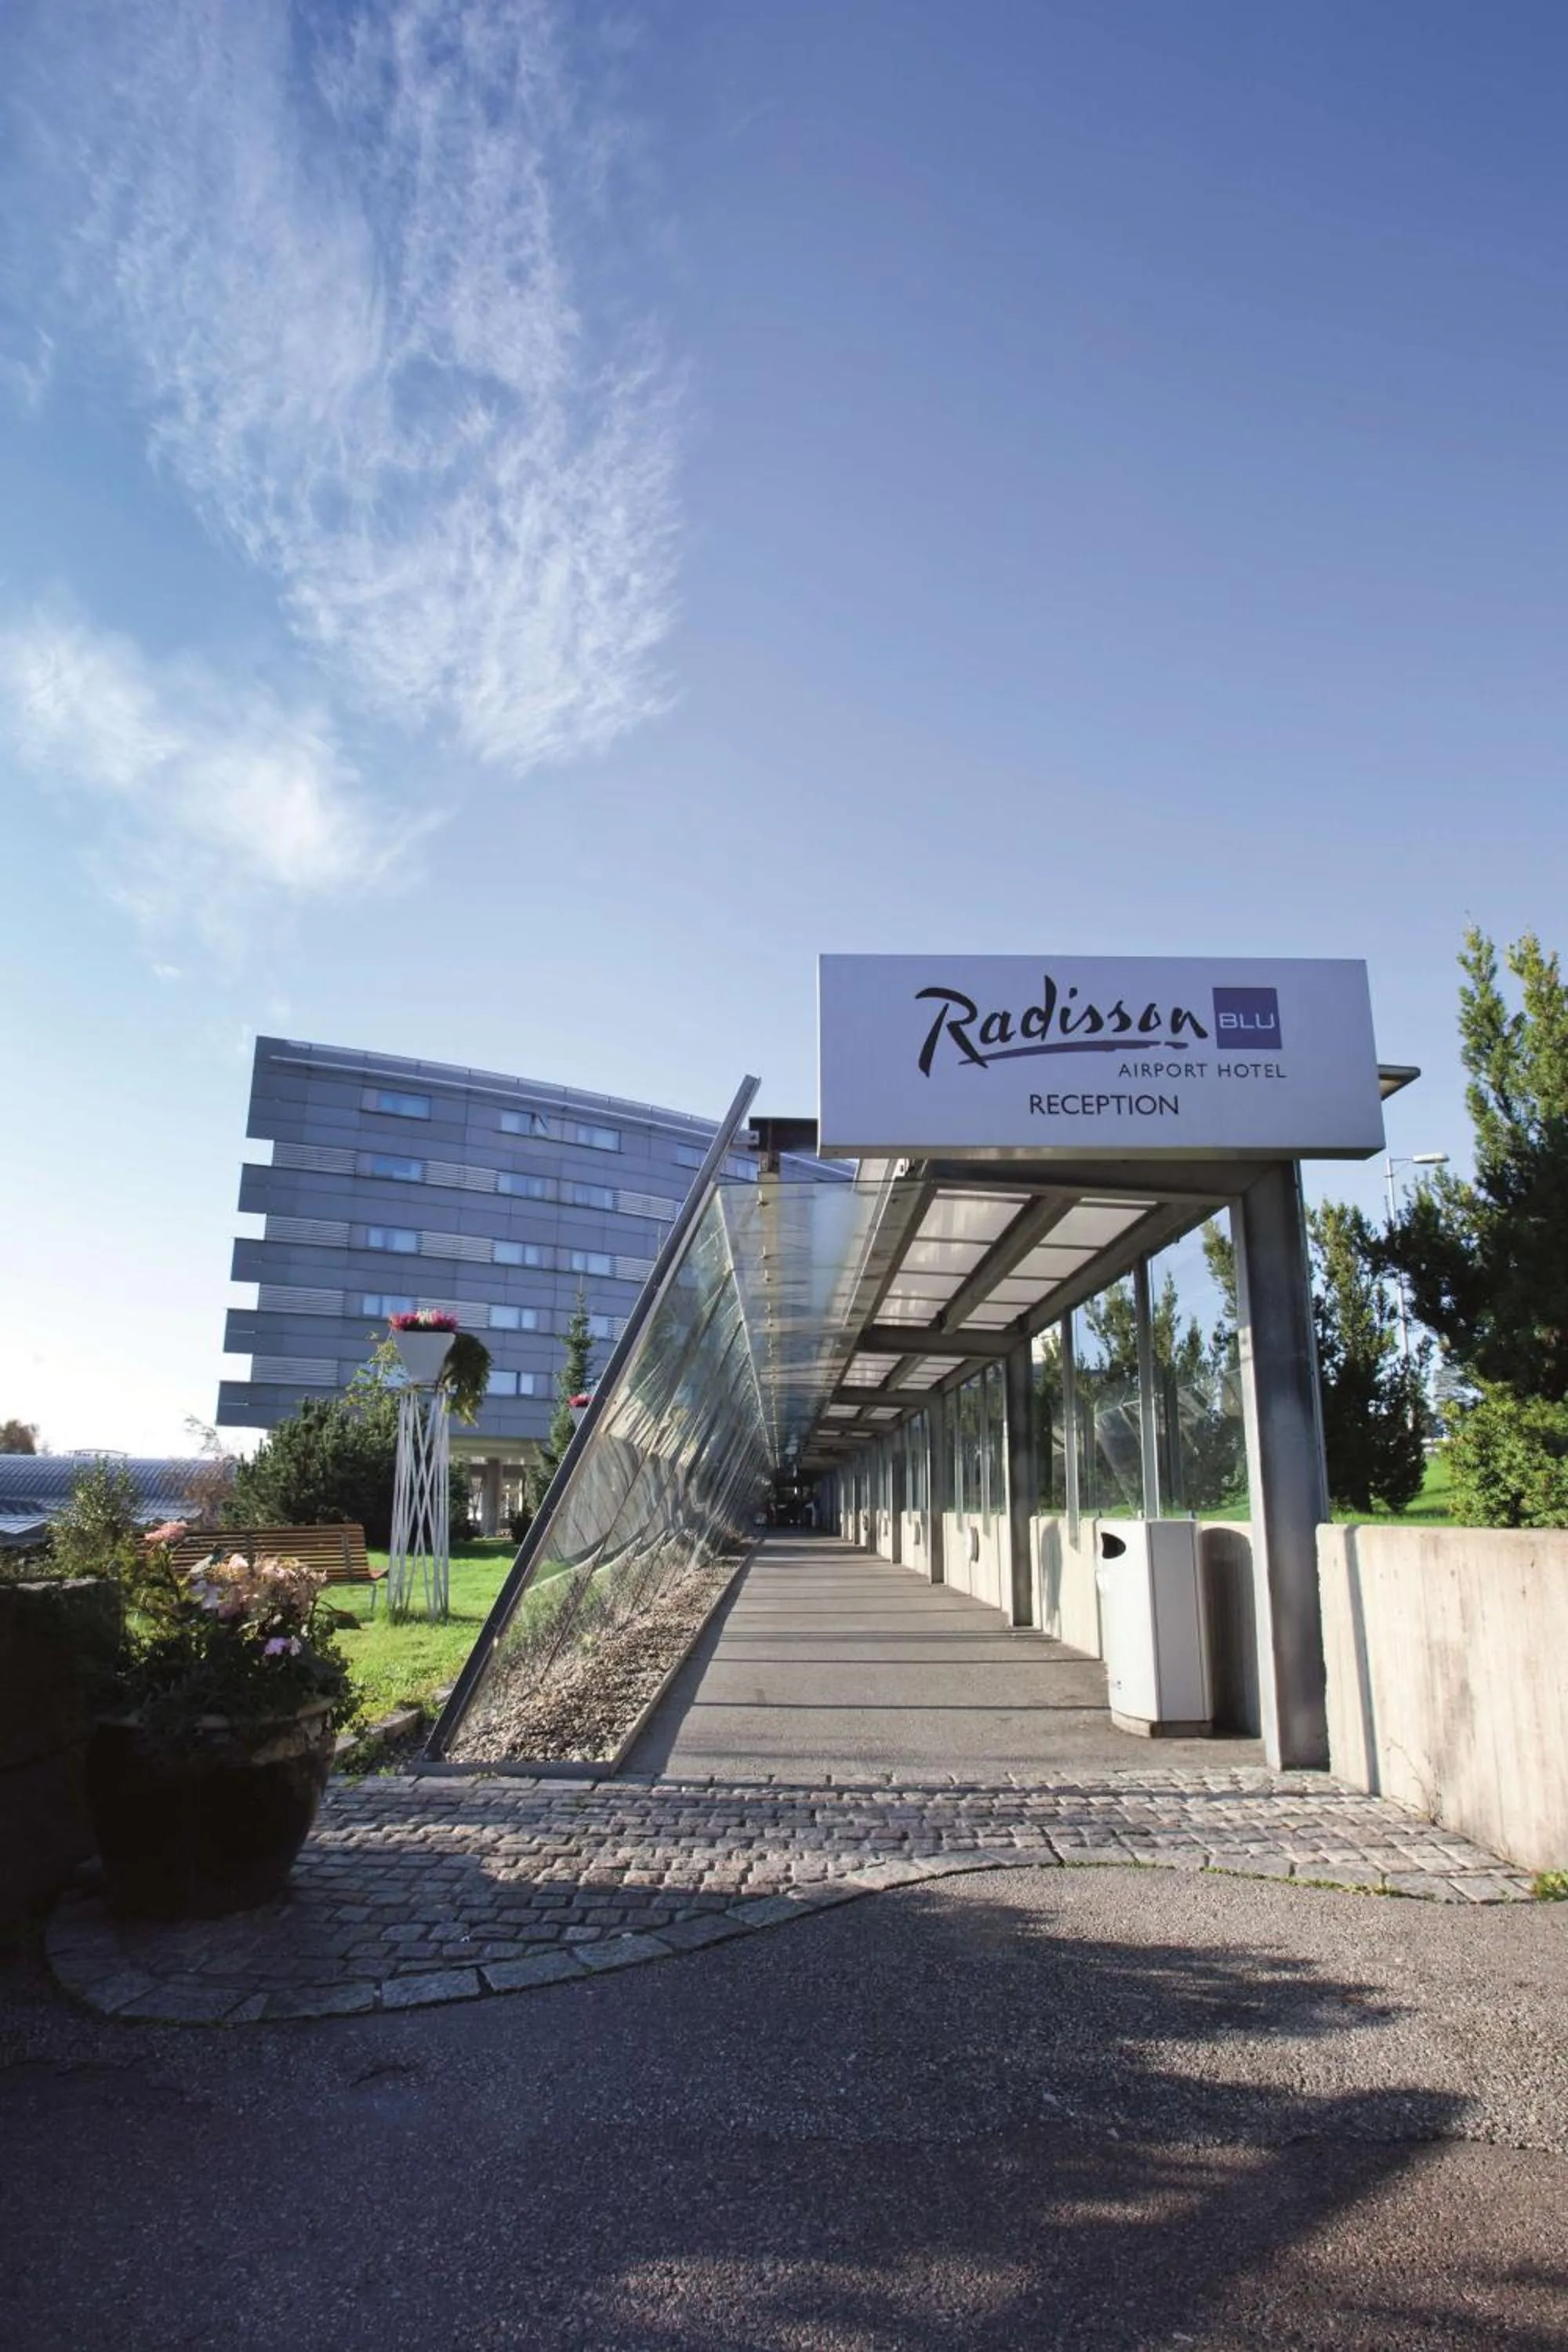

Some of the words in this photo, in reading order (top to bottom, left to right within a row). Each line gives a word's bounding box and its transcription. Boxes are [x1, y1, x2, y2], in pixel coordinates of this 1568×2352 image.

[915, 975, 1208, 1077] Radisson
[1218, 1011, 1276, 1030] BLU
[1119, 1062, 1208, 1079] AIRPORT
[1218, 1062, 1287, 1080] HOTEL
[1029, 1094, 1179, 1116] RECEPTION
